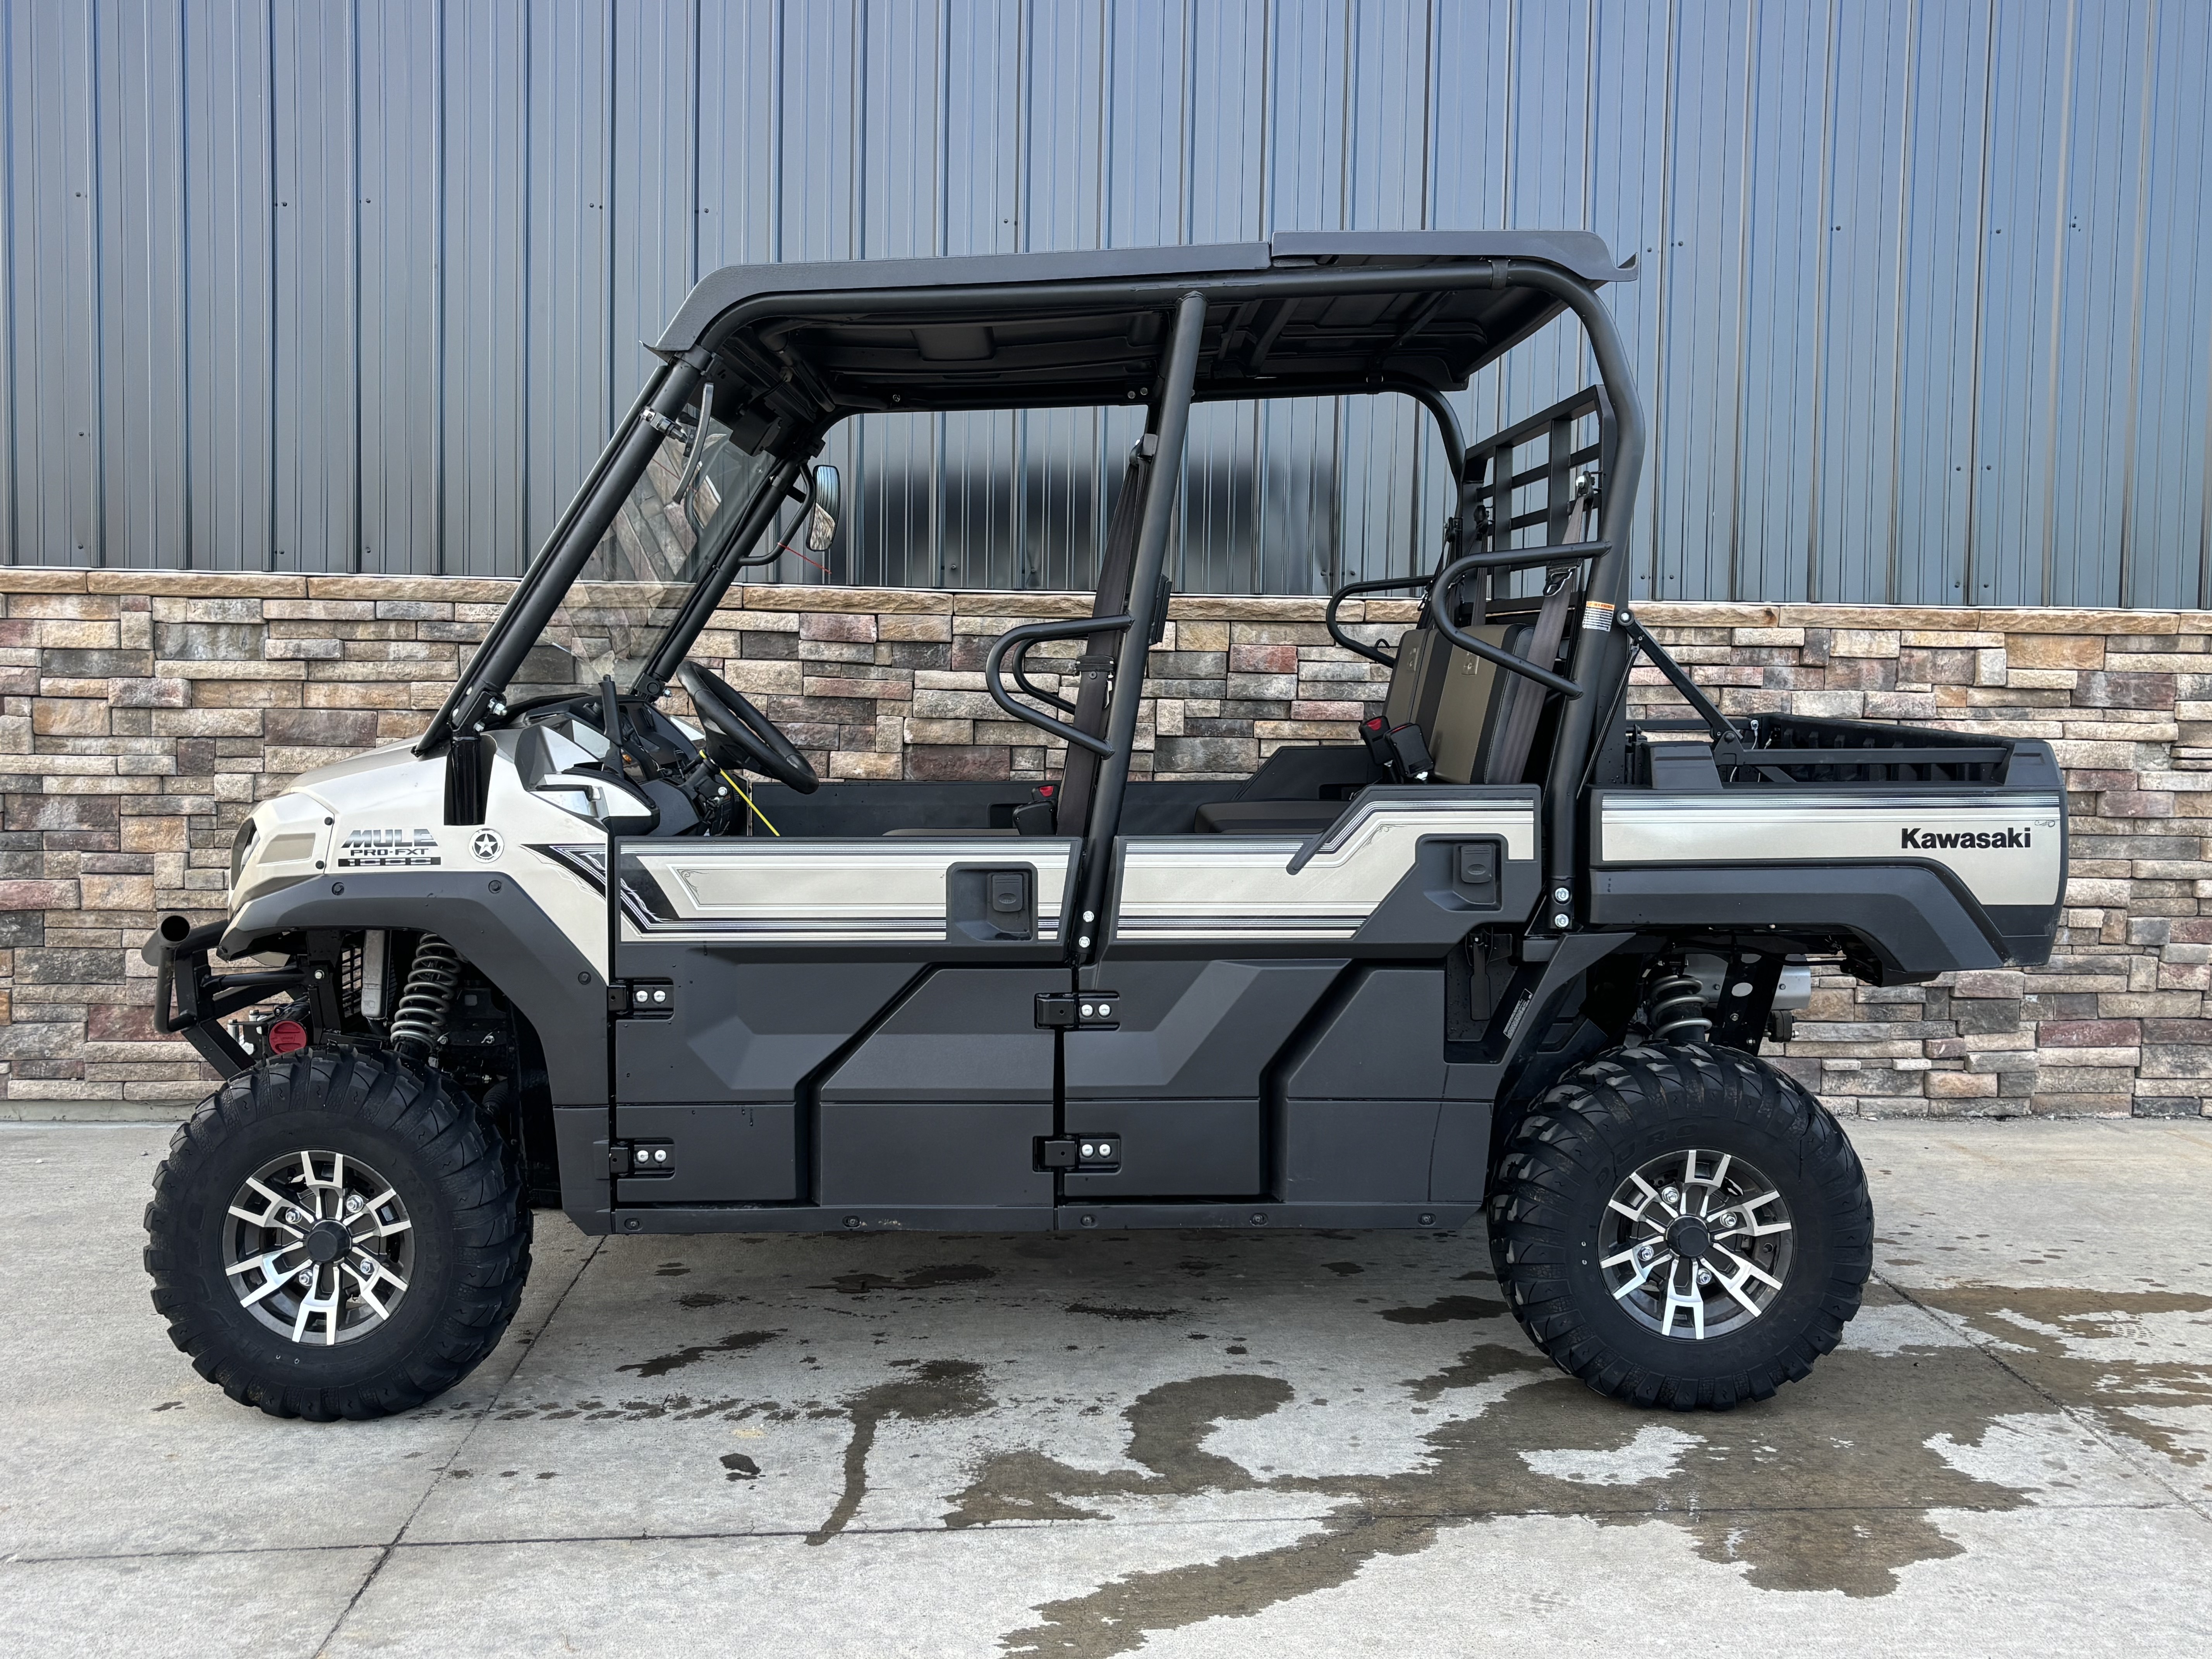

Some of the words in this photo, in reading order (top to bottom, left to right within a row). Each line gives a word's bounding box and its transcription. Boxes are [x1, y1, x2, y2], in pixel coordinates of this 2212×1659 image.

[341, 829, 438, 848] MULE
[1901, 827, 2031, 848] Kawasaki
[348, 858, 431, 866] 1000
